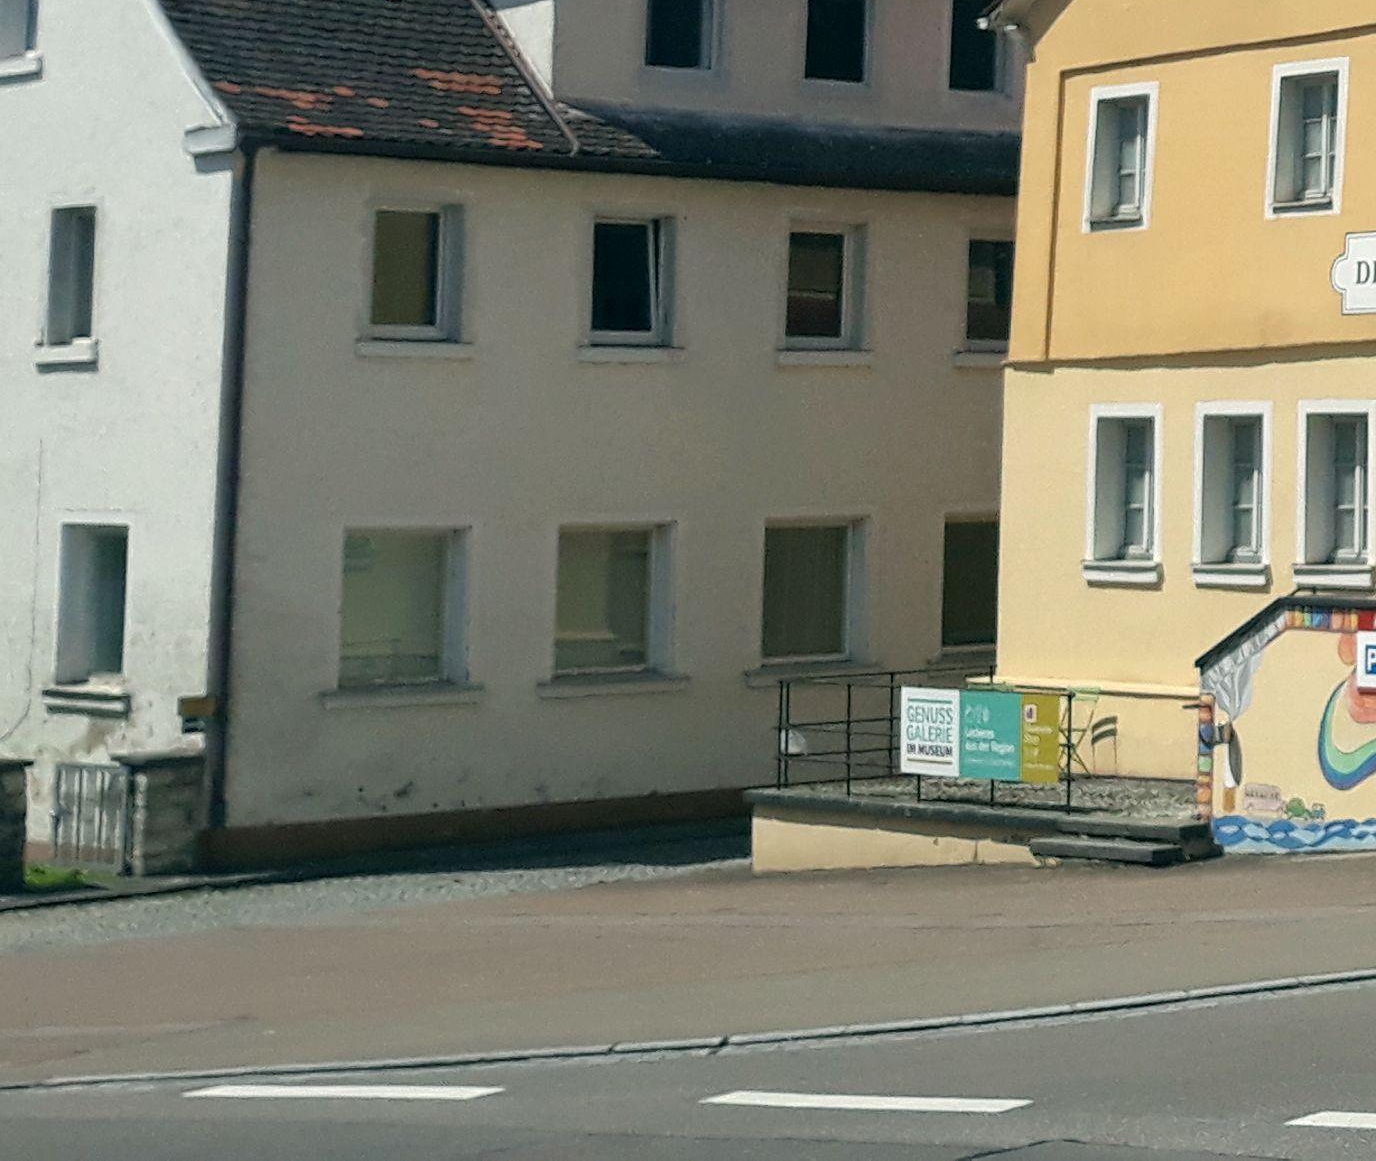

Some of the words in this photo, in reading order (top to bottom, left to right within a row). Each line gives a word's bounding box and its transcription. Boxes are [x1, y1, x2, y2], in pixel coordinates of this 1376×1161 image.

[906, 705, 953, 726] GENUSS
[906, 724, 953, 744] GALERIE
[906, 743, 917, 755] IM
[918, 744, 953, 758] MUSEUM
